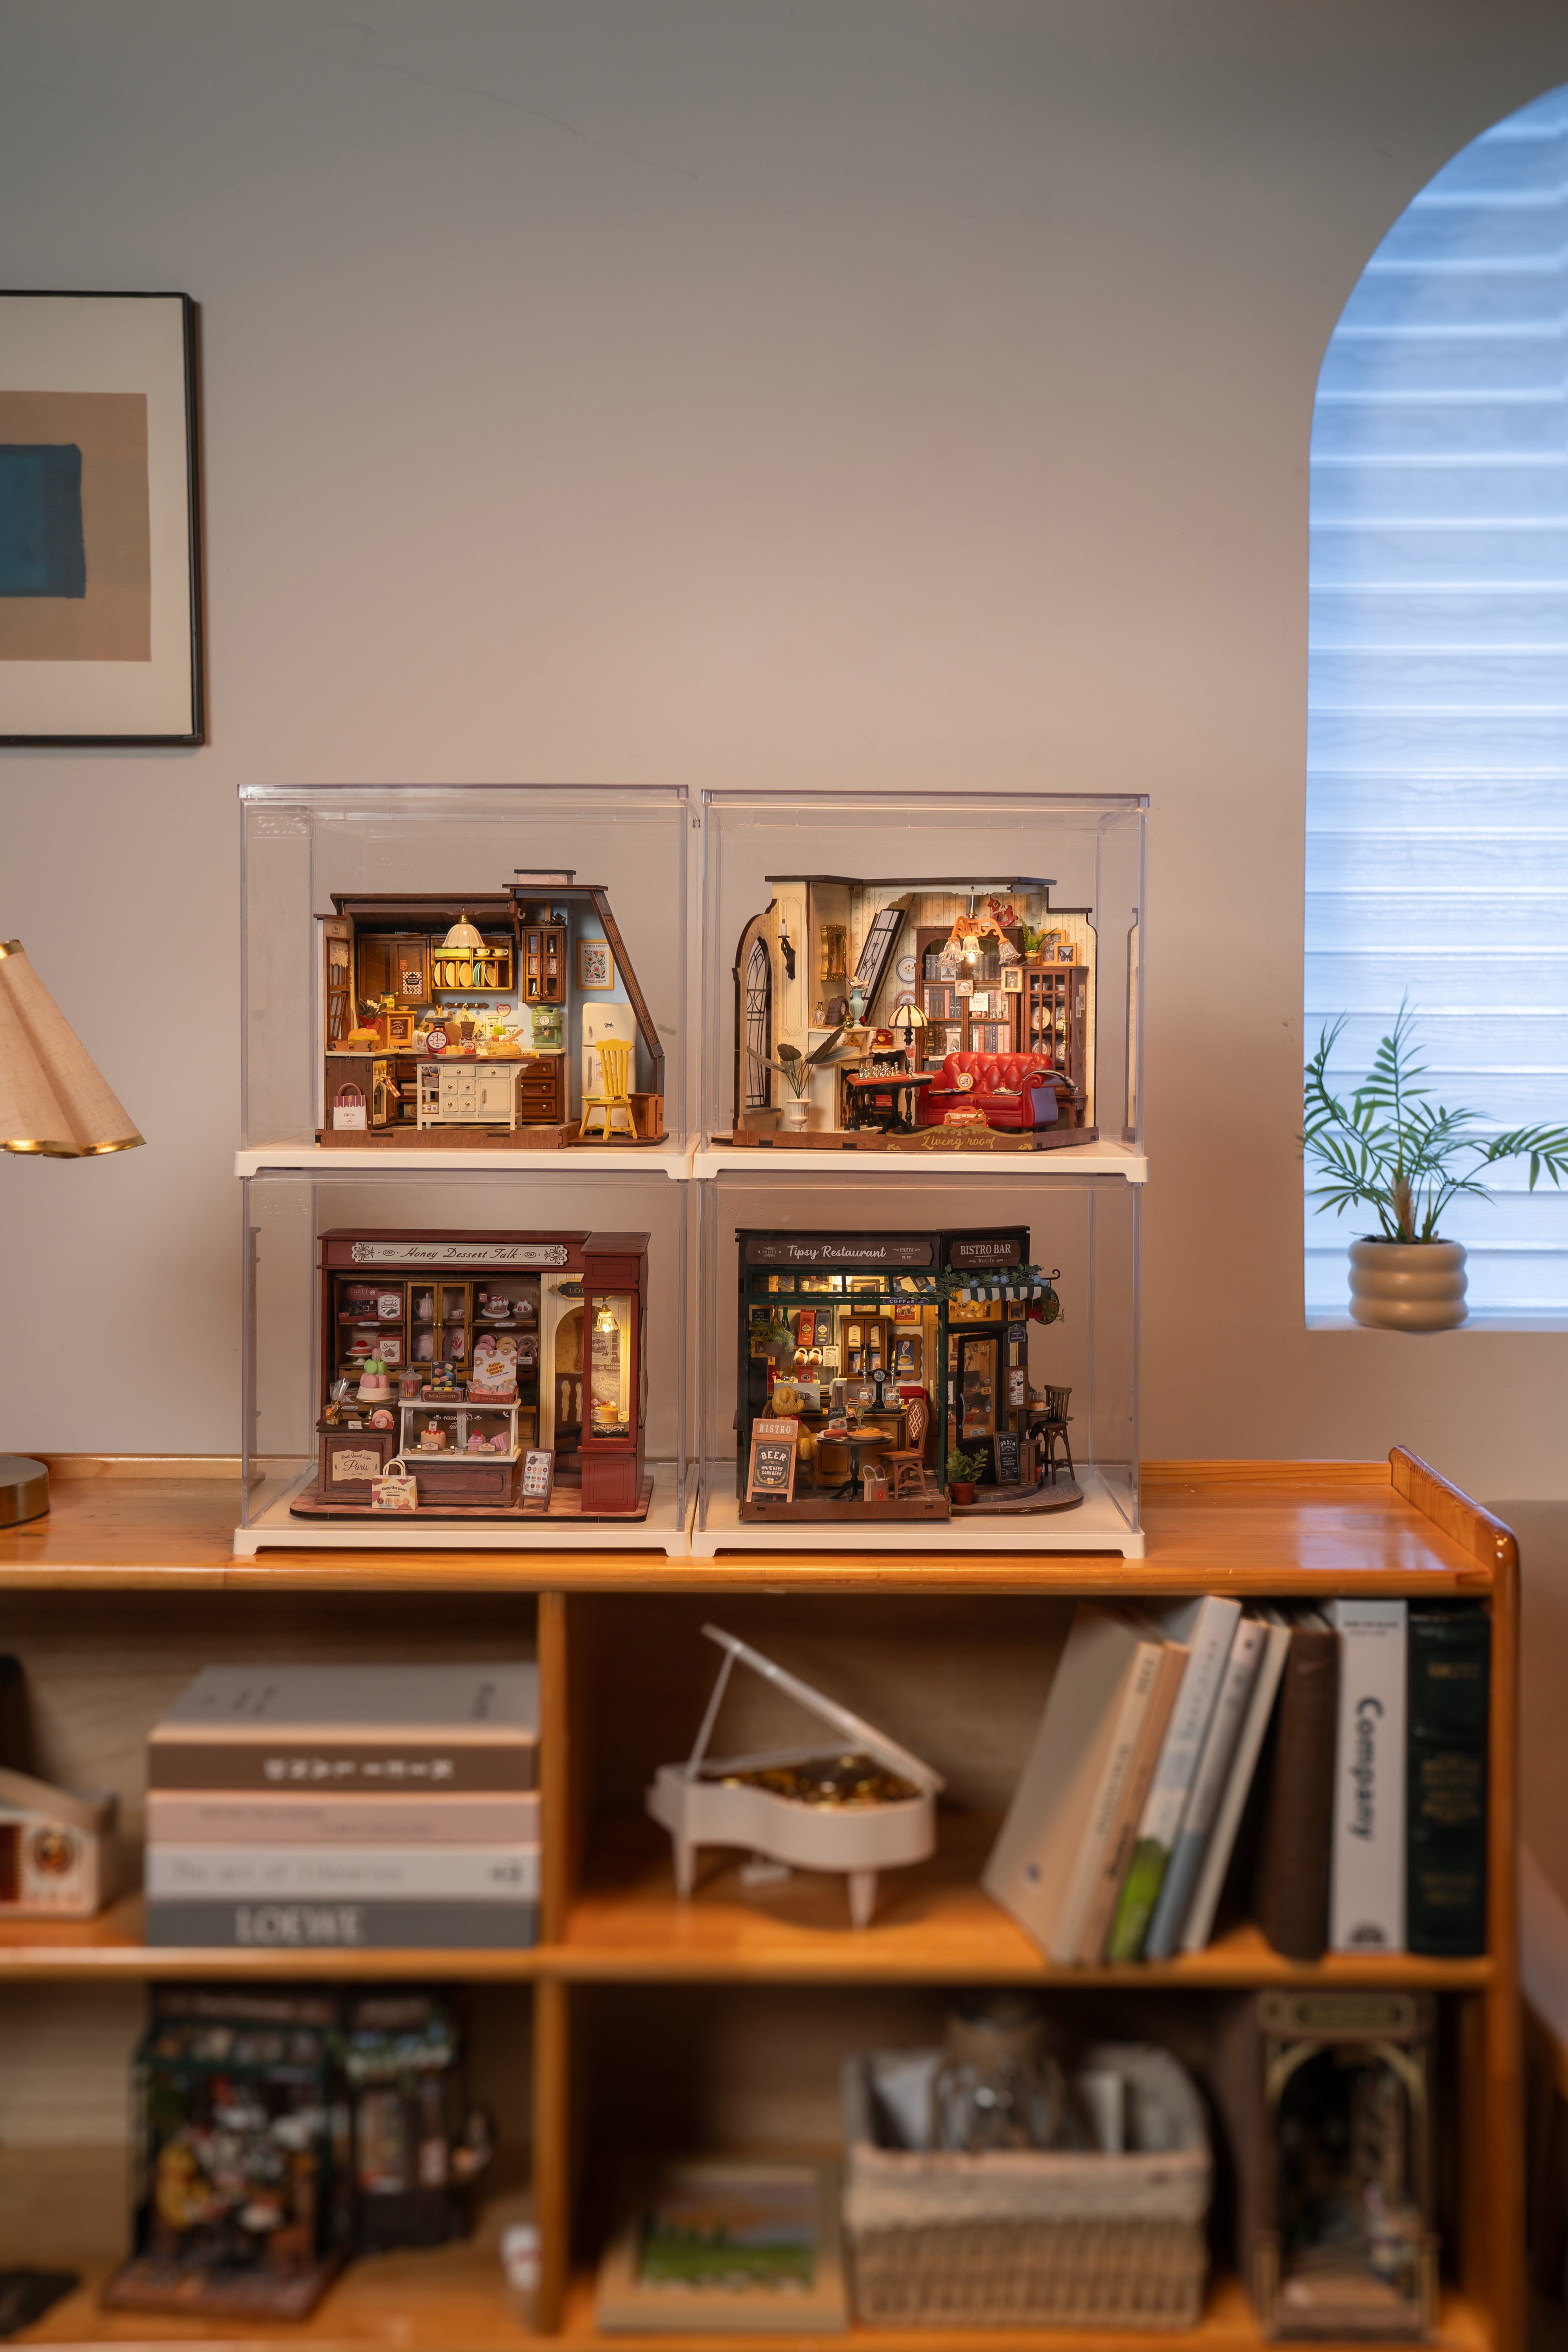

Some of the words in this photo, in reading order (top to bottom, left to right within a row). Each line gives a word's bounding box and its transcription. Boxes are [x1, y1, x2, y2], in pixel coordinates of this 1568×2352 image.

[921, 1136, 964, 1150] Living
[967, 1136, 996, 1149] room
[400, 1247, 439, 1260] Honey
[443, 1248, 488, 1259] Dessert
[489, 1249, 517, 1259] Talk
[787, 1245, 819, 1259] Tipsy
[822, 1245, 887, 1258] Restaurant
[960, 1245, 992, 1255] BISTRO
[994, 1244, 1011, 1254] BAR
[759, 1424, 791, 1434] BISTRO
[761, 1451, 787, 1462] BEER
[343, 1460, 369, 1471] Paris
[1350, 1695, 1384, 1842] Company
[236, 1906, 363, 1945] LOEWE
